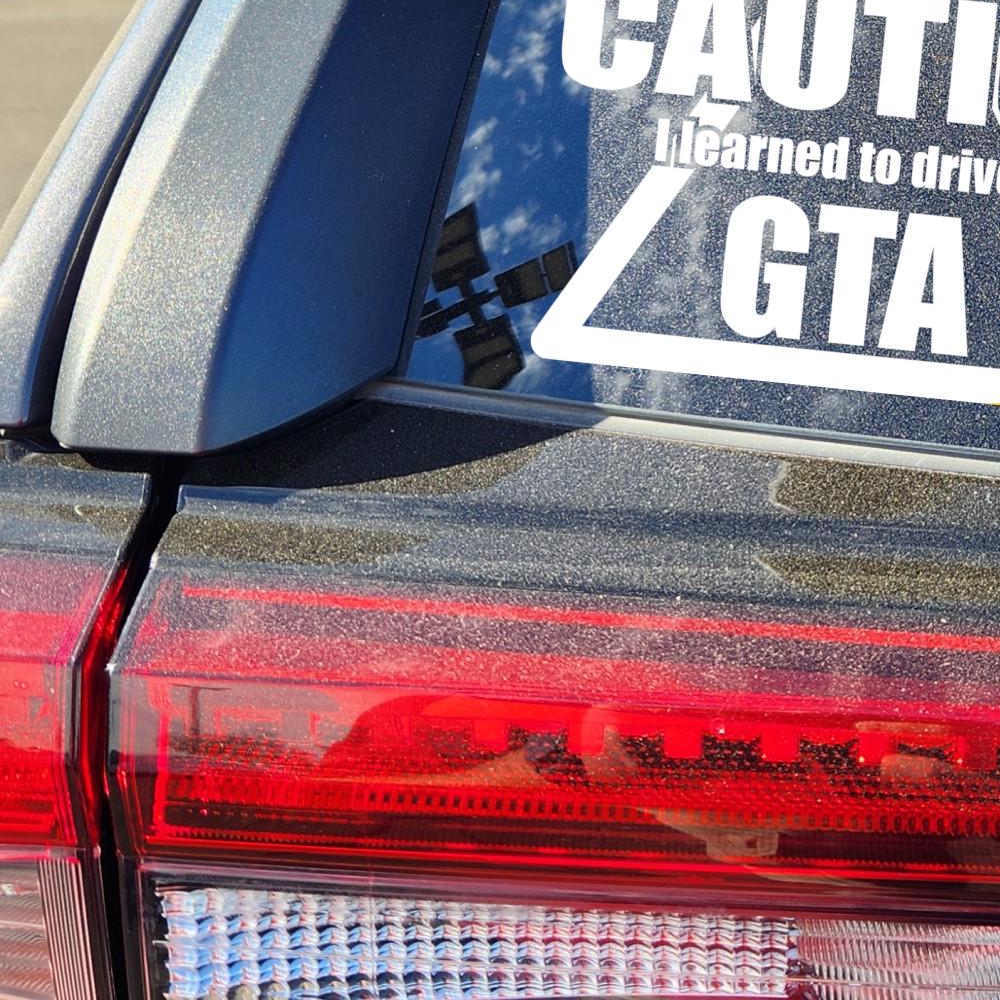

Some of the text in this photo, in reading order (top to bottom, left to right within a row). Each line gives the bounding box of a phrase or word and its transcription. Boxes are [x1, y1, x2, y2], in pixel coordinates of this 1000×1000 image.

[654, 118, 671, 162] I
[679, 118, 850, 180] learned
[858, 141, 901, 185] to
[719, 195, 968, 357] GTA
